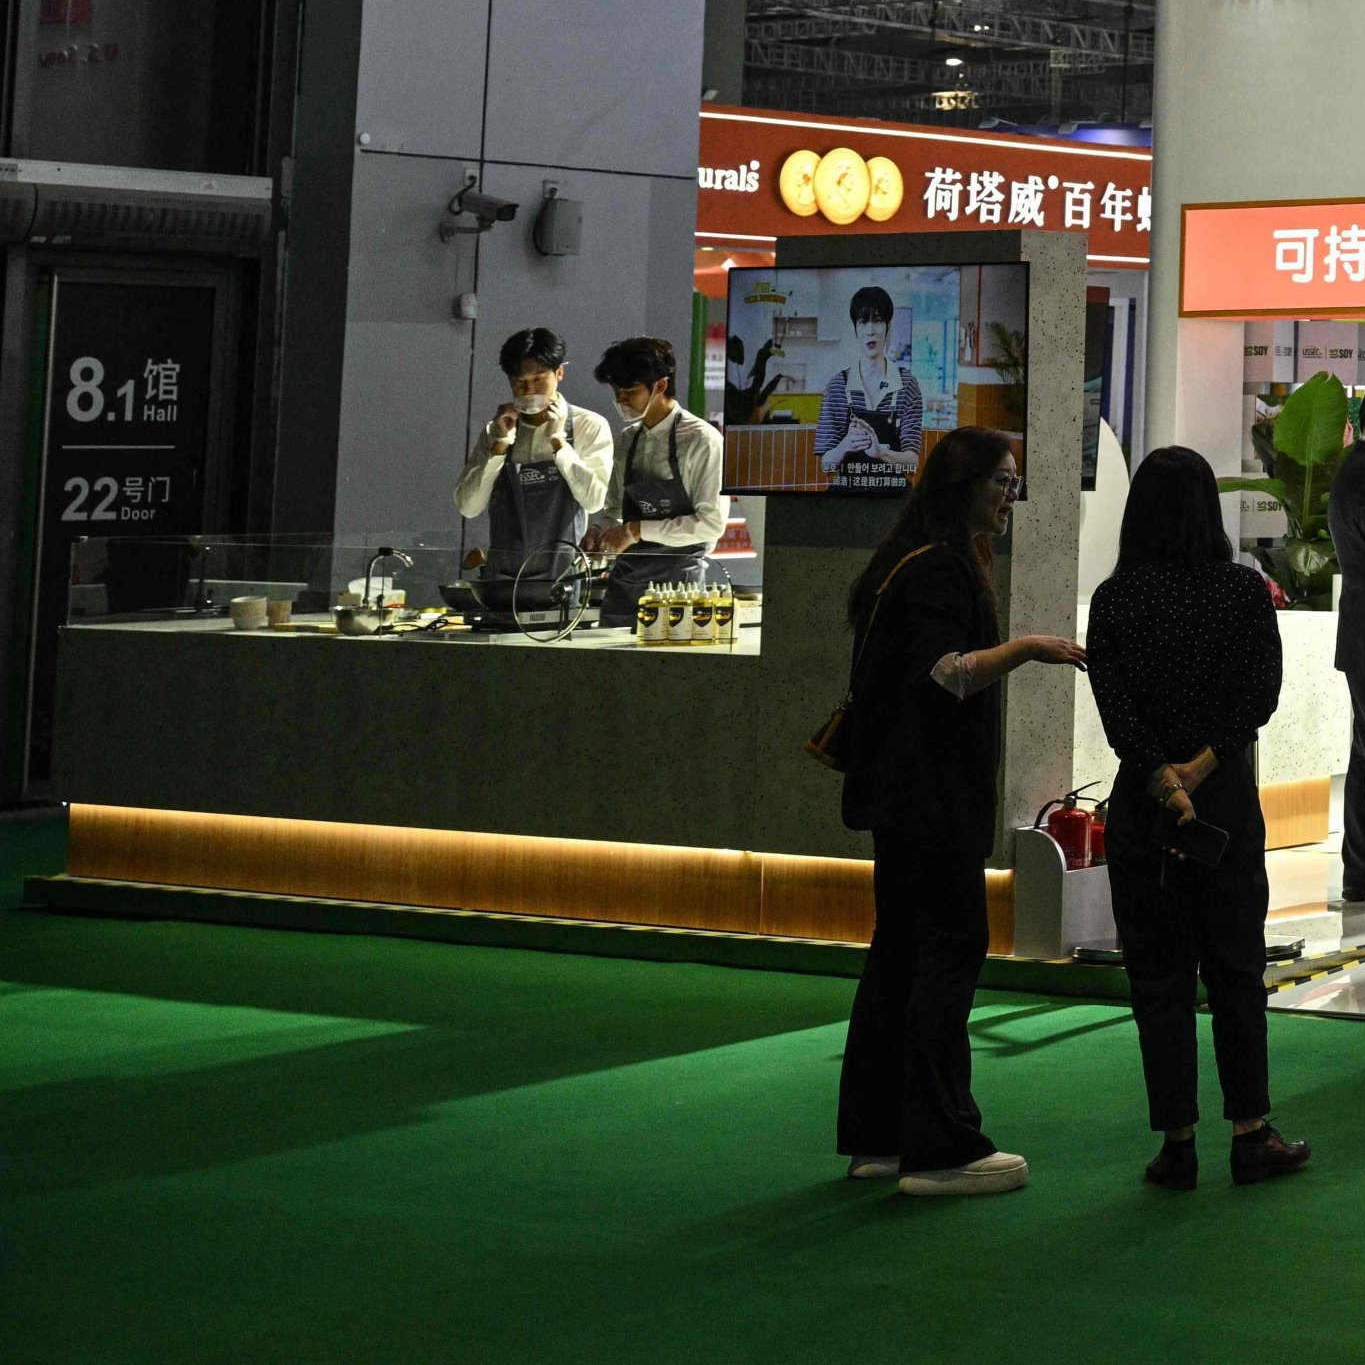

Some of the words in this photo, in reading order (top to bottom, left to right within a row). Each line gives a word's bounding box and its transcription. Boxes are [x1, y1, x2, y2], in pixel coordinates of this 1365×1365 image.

[1253, 345, 1269, 356] SOY
[1337, 348, 1354, 359] SOY
[143, 358, 181, 401] 馆
[66, 356, 136, 422] 8.1
[143, 405, 178, 422] Hall
[847, 463, 869, 474] 만들어
[871, 463, 893, 474] 보려고
[895, 463, 917, 474] 합니다
[852, 476, 906, 487] 这是我打算做的
[122, 476, 171, 503] 号门
[61, 476, 119, 521] 22
[120, 506, 156, 520] Door
